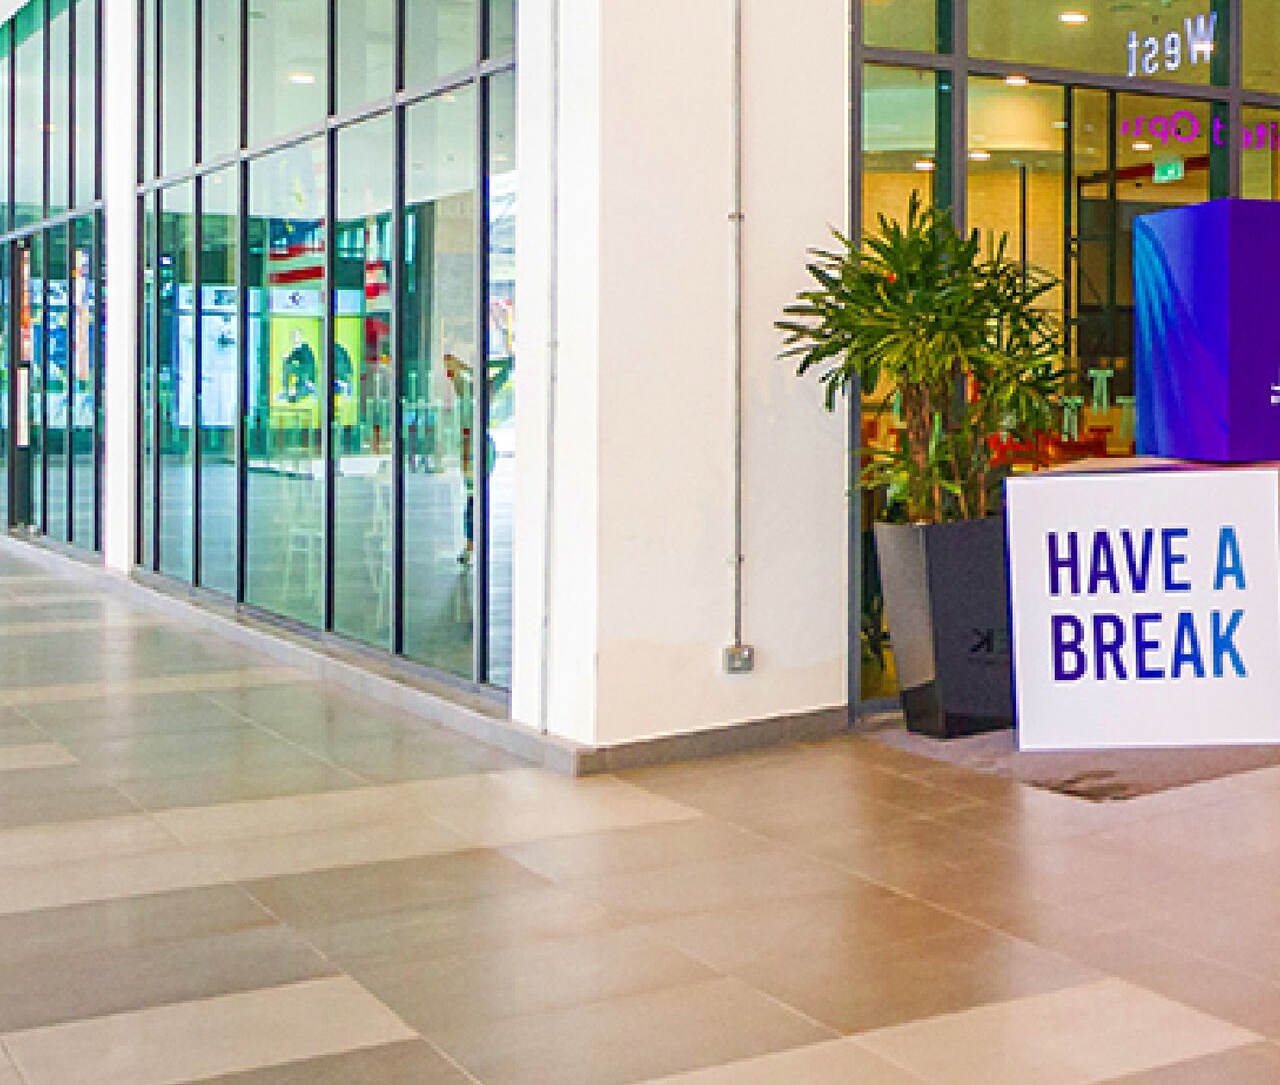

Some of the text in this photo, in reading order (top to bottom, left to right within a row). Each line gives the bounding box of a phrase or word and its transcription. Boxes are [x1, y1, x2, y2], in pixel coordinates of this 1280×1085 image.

[1046, 525, 1247, 596] HAVE A
[1050, 607, 1248, 683] BREAK
